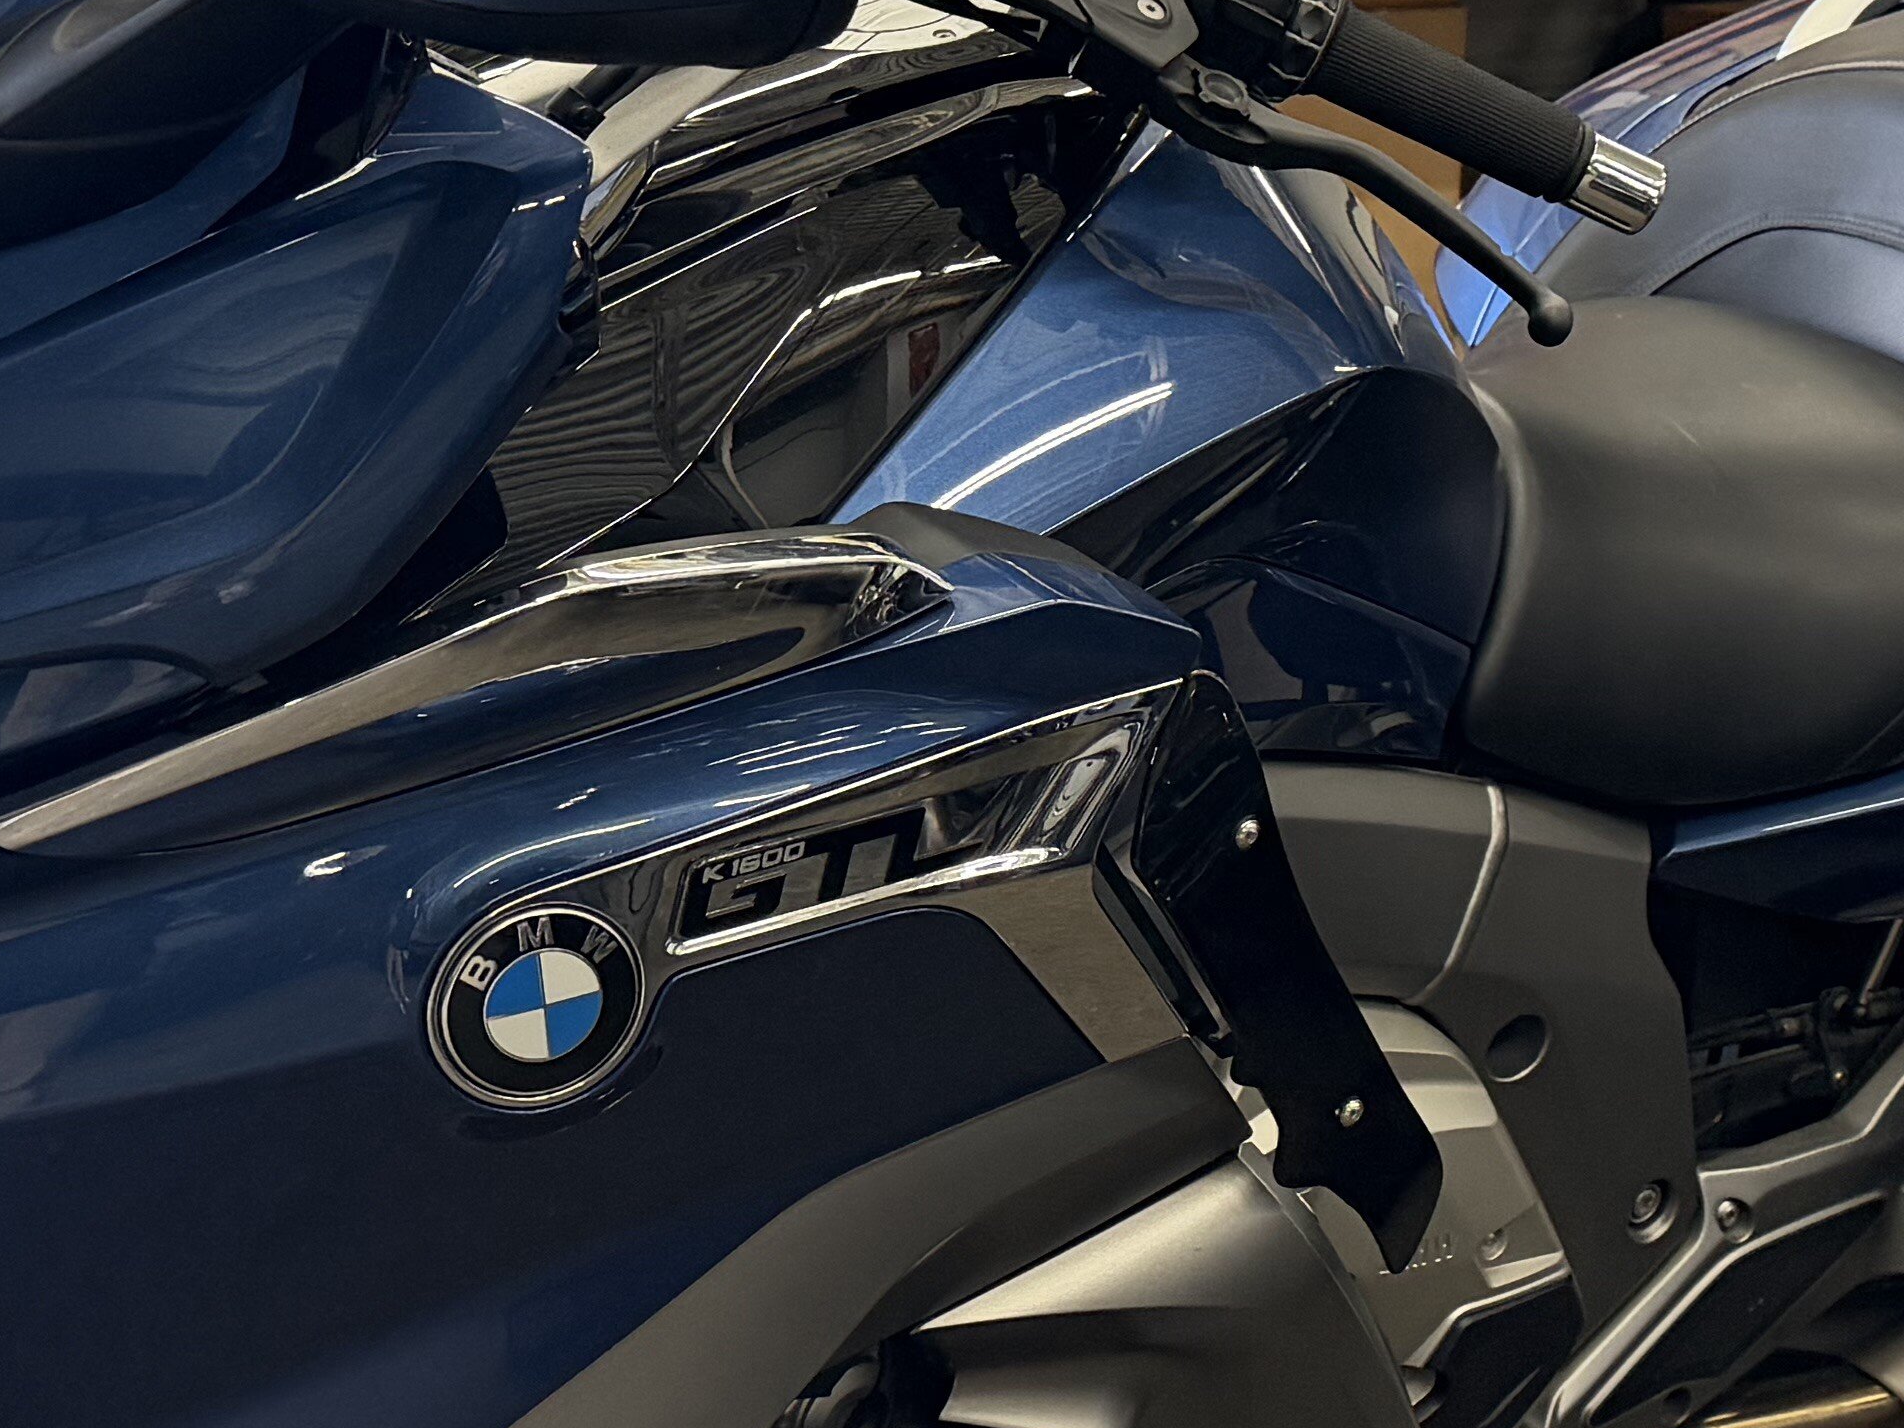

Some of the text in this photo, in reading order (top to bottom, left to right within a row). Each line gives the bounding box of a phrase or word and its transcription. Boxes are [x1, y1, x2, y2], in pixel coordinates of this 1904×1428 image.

[702, 841, 806, 884] K 1600
[460, 916, 616, 992] BMW
